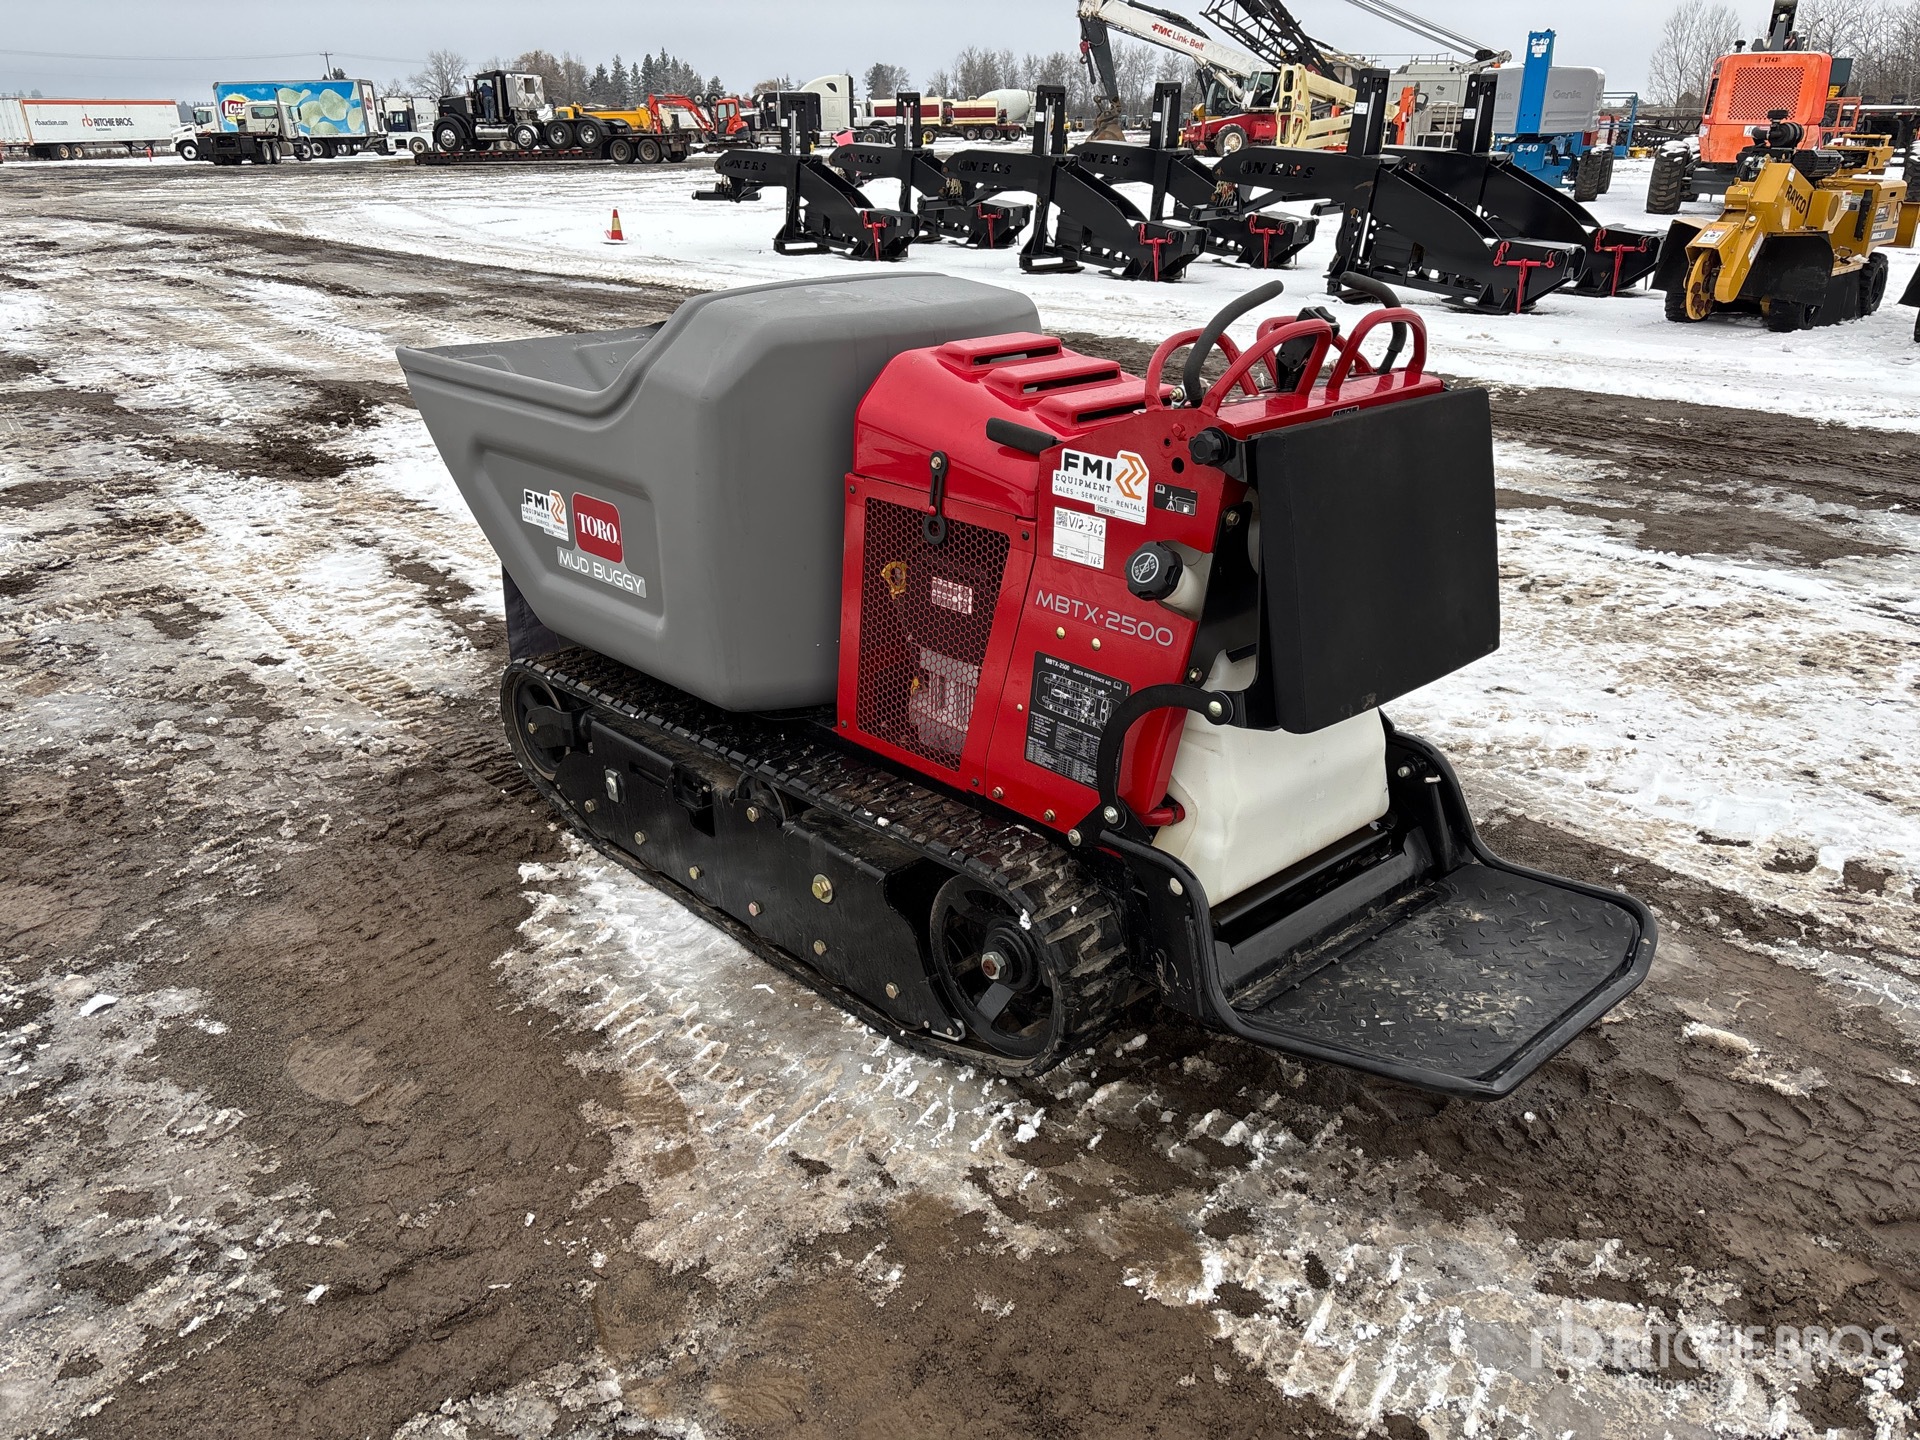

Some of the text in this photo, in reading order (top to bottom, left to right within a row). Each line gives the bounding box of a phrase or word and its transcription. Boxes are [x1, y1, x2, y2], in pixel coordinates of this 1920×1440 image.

[1151, 23, 1205, 51] FMC Link-Belt
[1497, 91, 1512, 100] nie
[1553, 90, 1581, 99] Genie
[35, 118, 68, 126] rbauction.com
[93, 118, 115, 127] RITCHIE
[1517, 144, 1538, 152] S-40
[1785, 184, 1807, 215] RAYCO
[1063, 452, 1112, 481] FMI
[1055, 474, 1111, 493] EQUIPMENT
[525, 491, 549, 511] FMI
[1054, 485, 1145, 513] SALES SERVICE RENTALS
[522, 506, 550, 520] EQUIPMENT
[577, 512, 618, 544] TORO
[559, 550, 643, 593] MUD BUGGY
[1045, 657, 1071, 671] MBTX-2500
[1072, 668, 1084, 676] QUICK
[1084, 672, 1105, 684] REFERENCE
